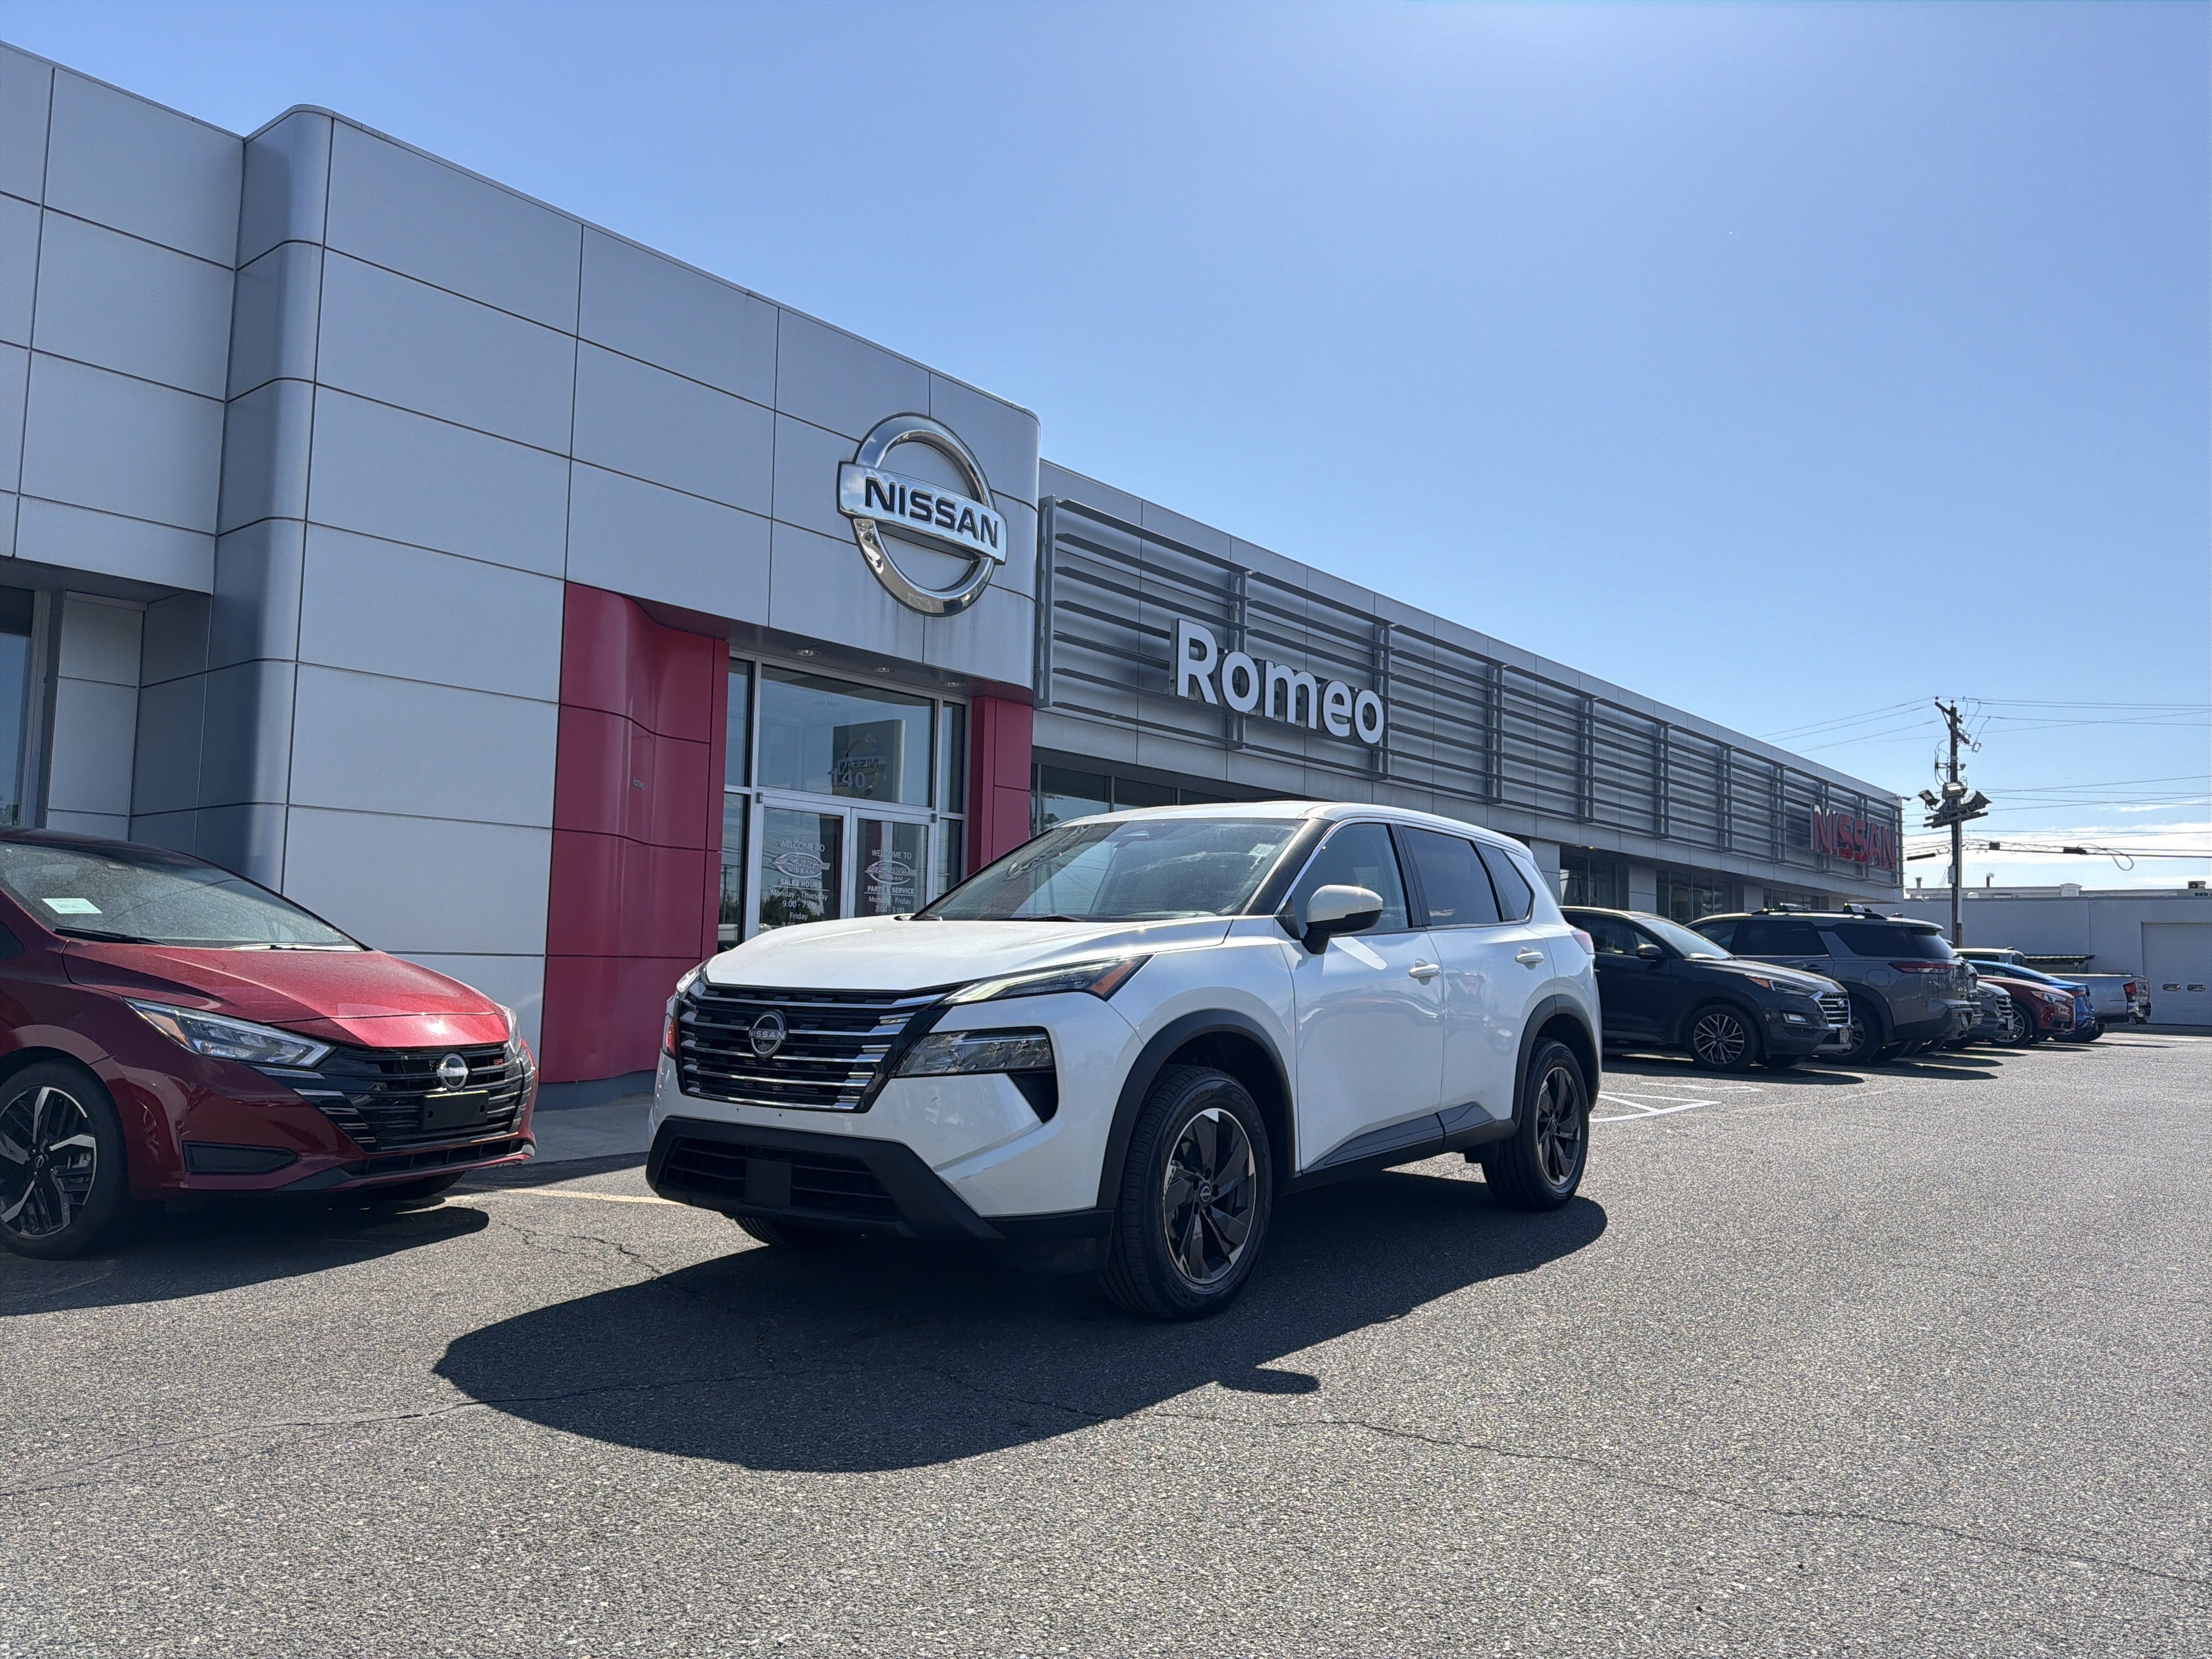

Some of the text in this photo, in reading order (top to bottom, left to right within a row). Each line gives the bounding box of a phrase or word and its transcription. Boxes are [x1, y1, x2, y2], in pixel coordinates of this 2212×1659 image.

[865, 476, 999, 549] NISSAN
[1176, 618, 1385, 744] Romeo
[828, 768, 866, 788] 140
[1813, 804, 1897, 870] NISSAN
[780, 839, 825, 852] WELCOME TO
[872, 849, 901, 859] WELCOME
[780, 878, 822, 889] SALES HOURS
[771, 889, 795, 899] Monday
[801, 891, 828, 901] Thursday
[782, 900, 797, 908] 9:00
[803, 901, 816, 909] 7:00
[895, 897, 911, 906] Friday
[789, 911, 809, 921] Friday
[748, 1029, 786, 1039] NISSAN
